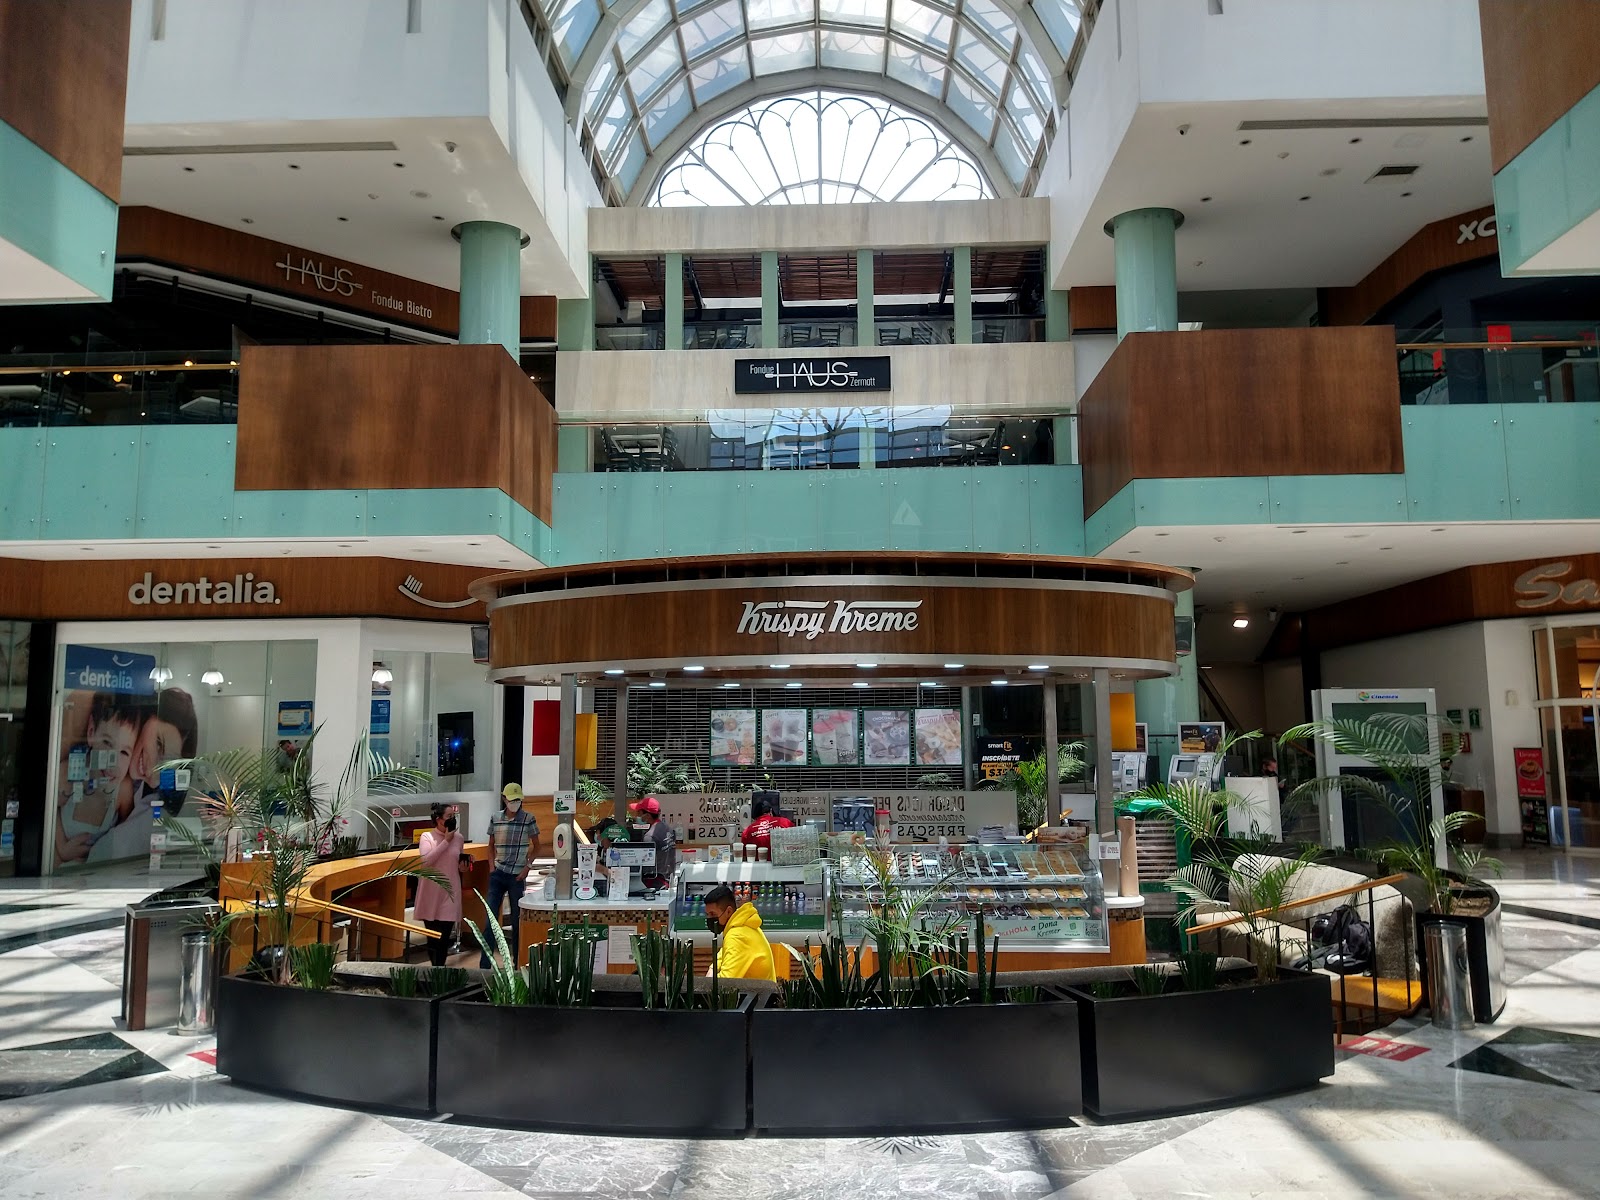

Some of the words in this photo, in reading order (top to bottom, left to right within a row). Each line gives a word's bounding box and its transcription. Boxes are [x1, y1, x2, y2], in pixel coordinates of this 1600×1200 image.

[278, 252, 360, 297] HAUS
[371, 290, 403, 312] Fondue
[406, 300, 433, 319] Bistro
[750, 364, 774, 375] Fondue
[772, 361, 853, 389] HAUS
[850, 376, 876, 387] Zermatt
[128, 572, 281, 605] dentalia.
[736, 600, 830, 640] Krispy
[828, 600, 923, 634] Kreme
[79, 665, 134, 690] dentalia
